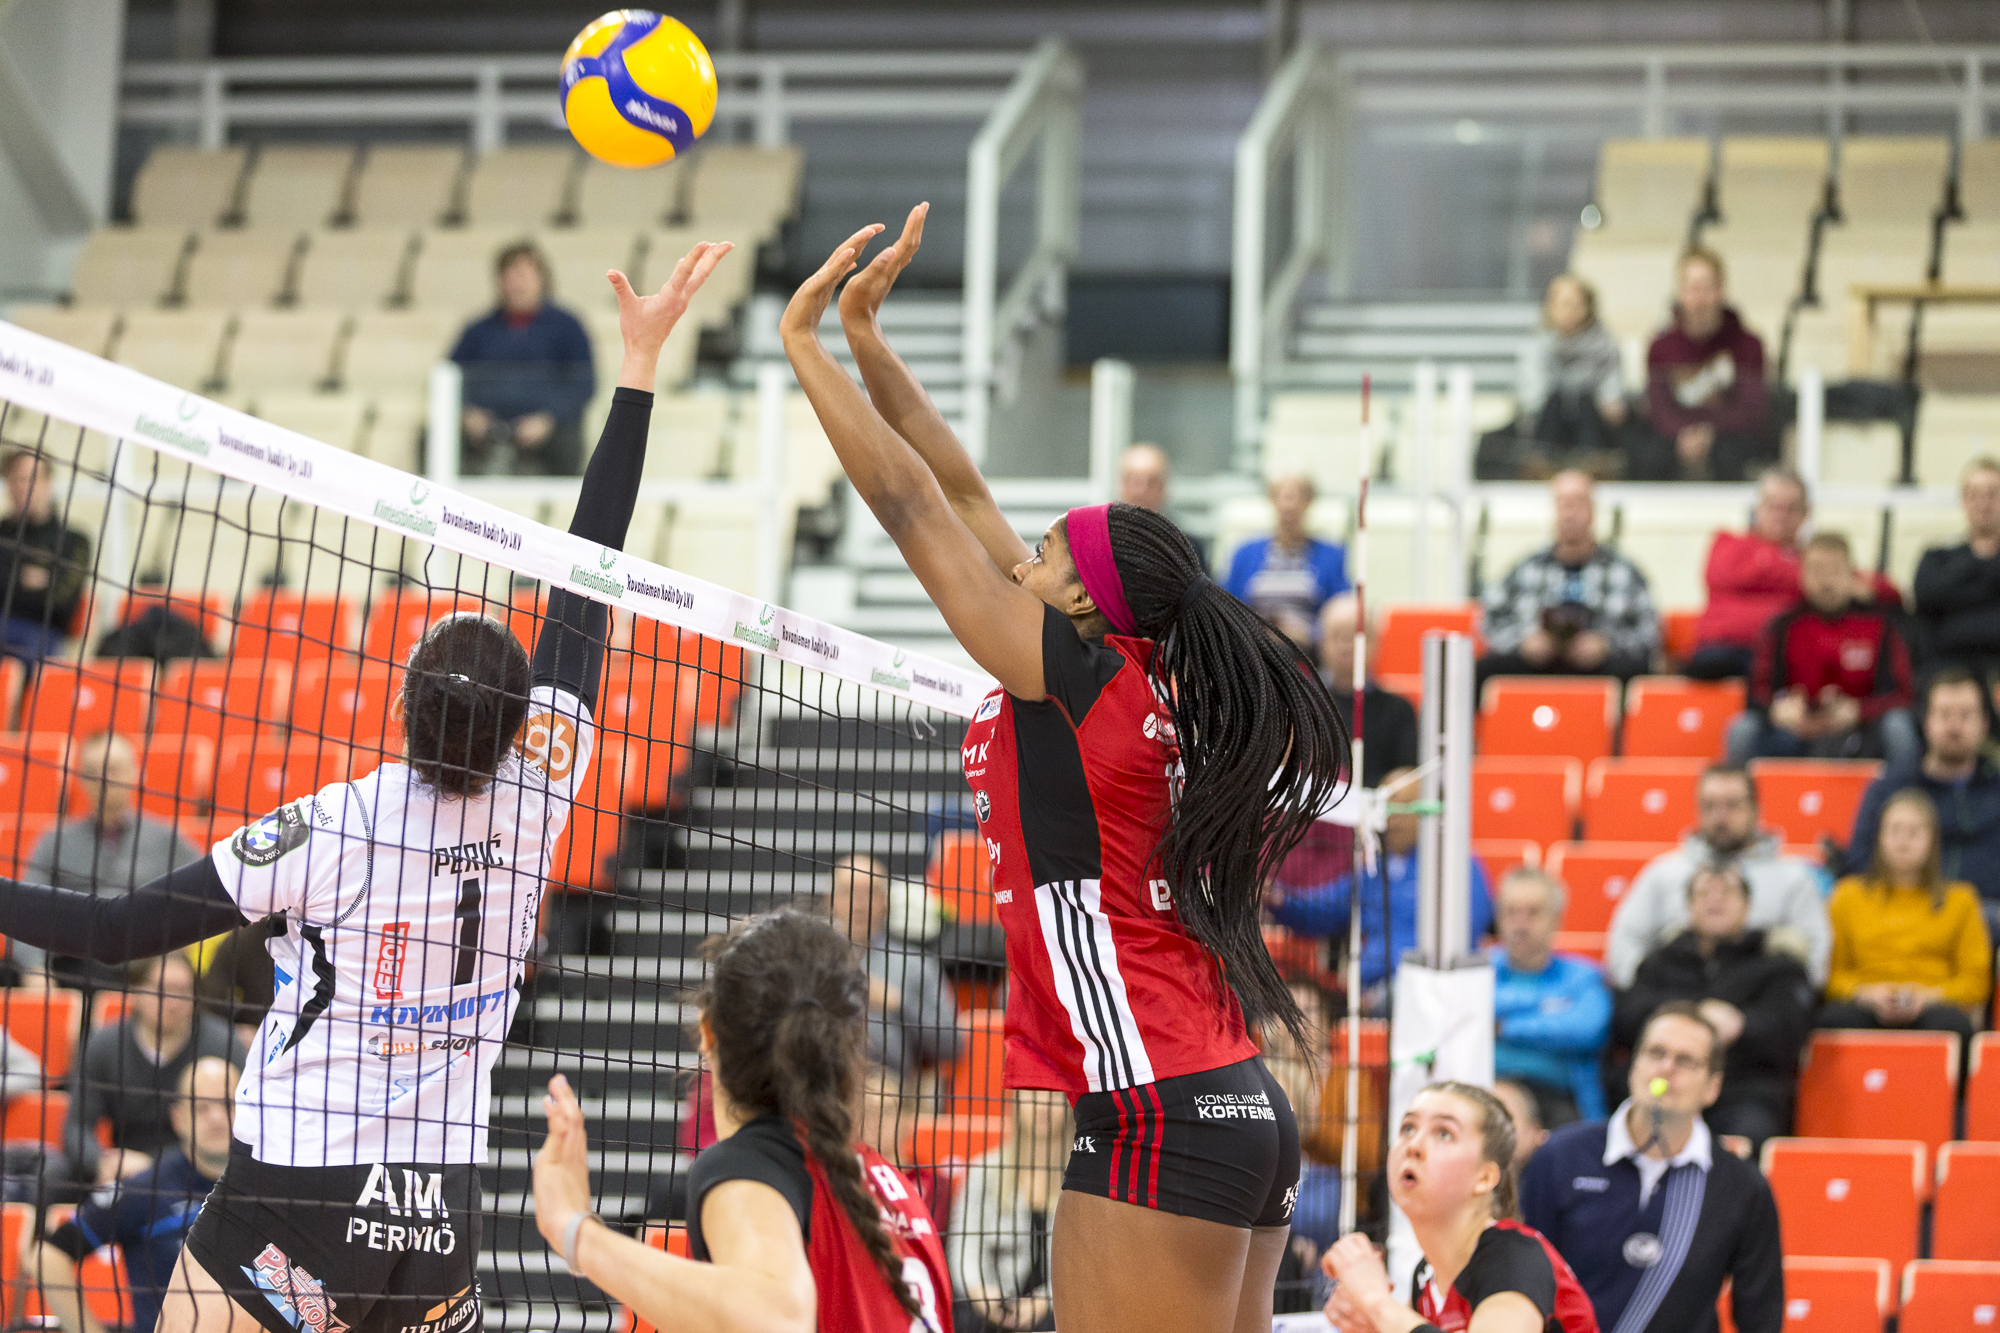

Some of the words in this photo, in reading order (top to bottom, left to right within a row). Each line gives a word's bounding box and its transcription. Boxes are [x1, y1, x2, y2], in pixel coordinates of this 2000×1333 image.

[627, 573, 661, 599] Rovaniemen
[660, 584, 675, 603] Kodit
[683, 591, 695, 610] LKV
[284, 806, 300, 828] CEV
[433, 833, 504, 877] PERIĆ
[455, 877, 482, 986] 1
[356, 1163, 449, 1219] AM
[346, 1217, 456, 1256] PERNIÖ
